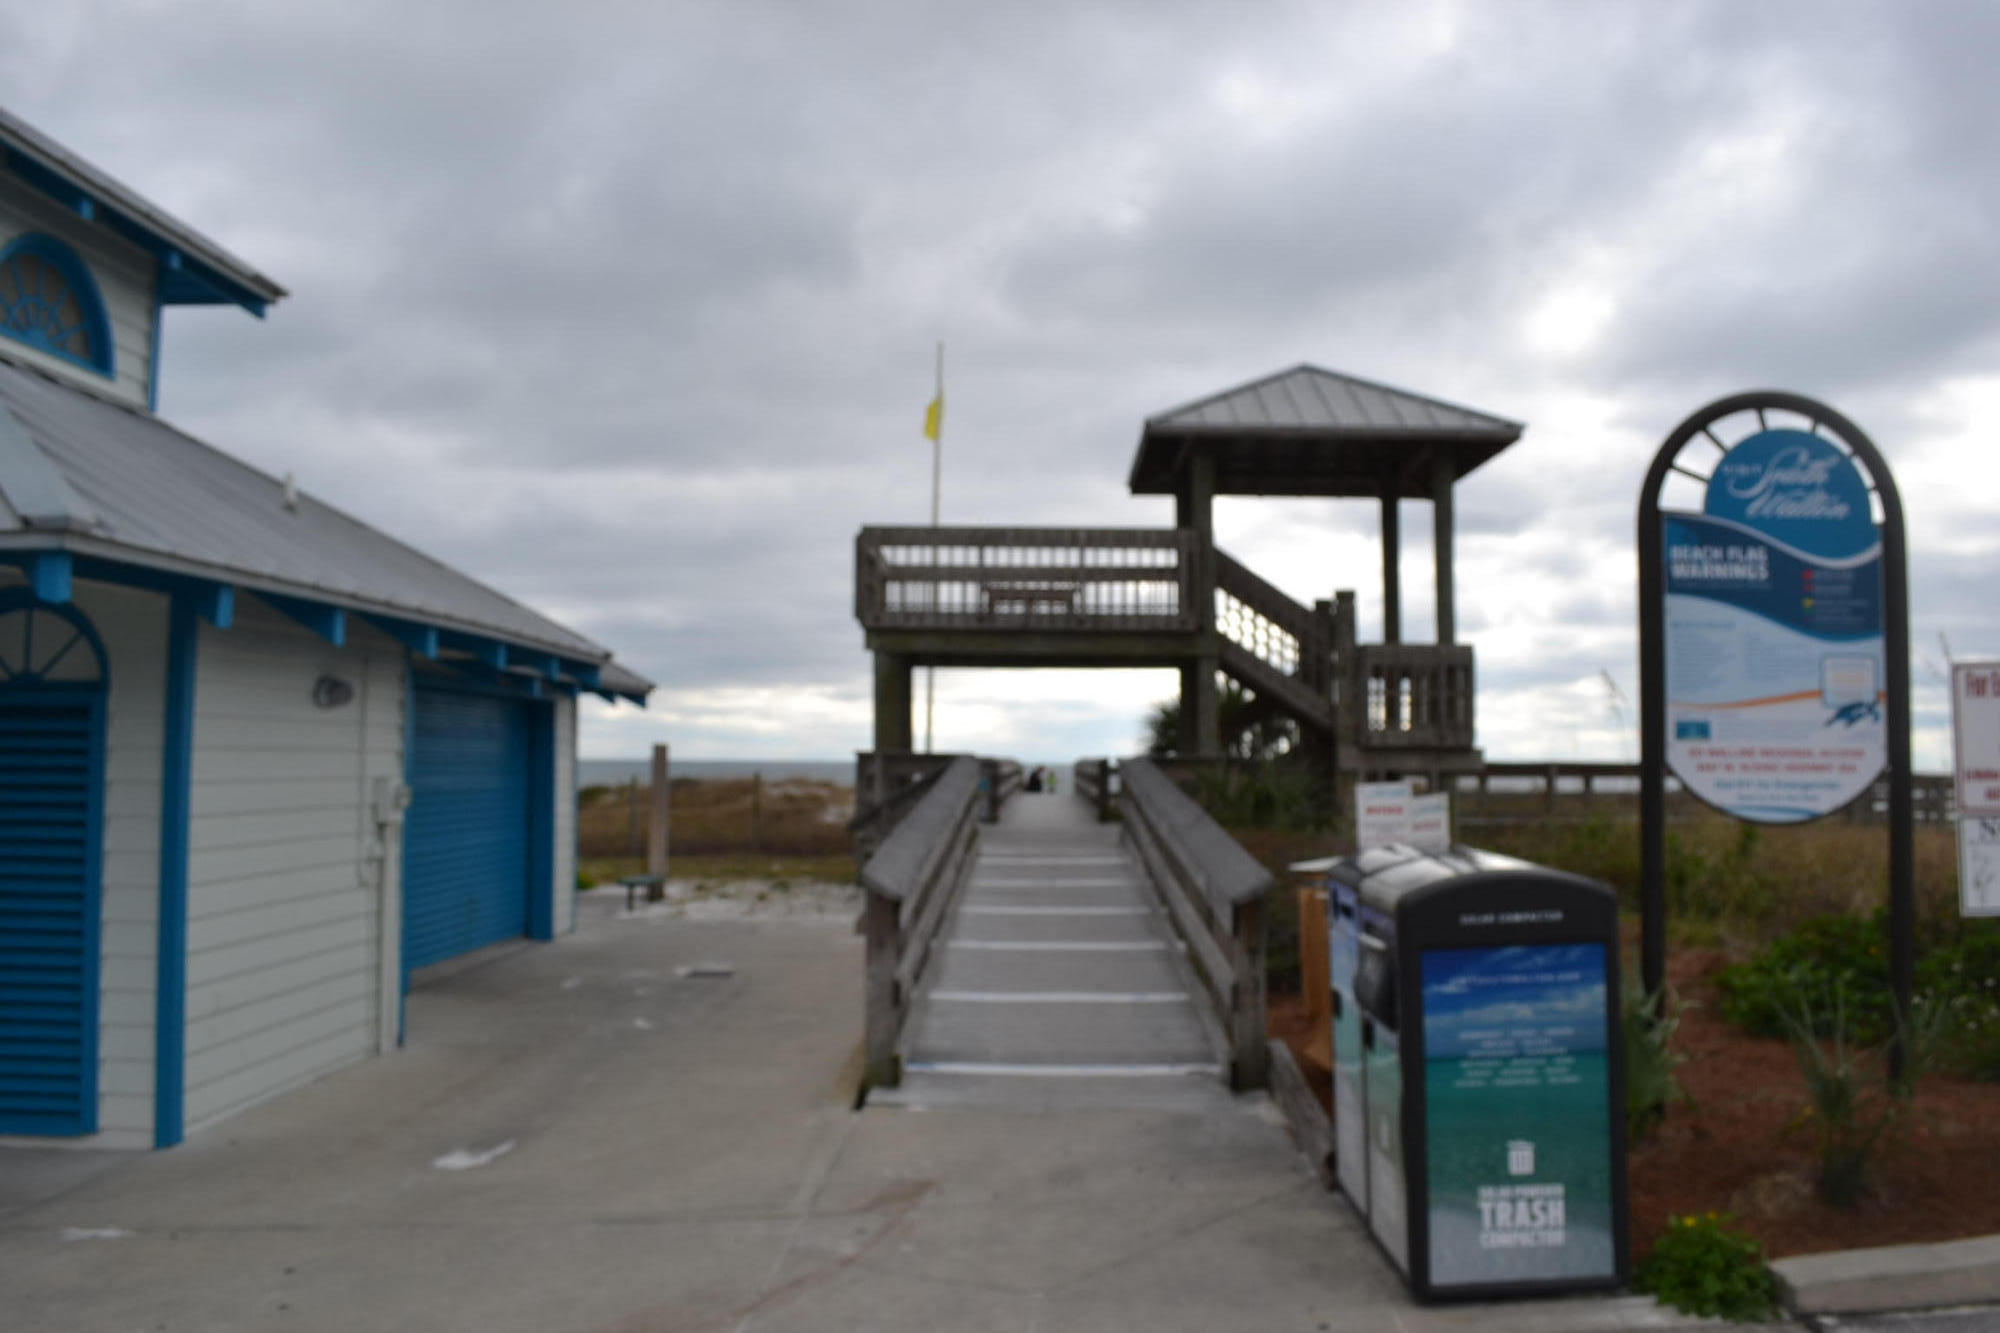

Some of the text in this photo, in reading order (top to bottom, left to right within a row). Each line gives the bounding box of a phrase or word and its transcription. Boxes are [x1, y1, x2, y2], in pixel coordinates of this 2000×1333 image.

[1670, 545, 1769, 561] BEACH FLAG
[1670, 561, 1770, 581] WARNINGS
[1479, 1200, 1564, 1229] TRASH
